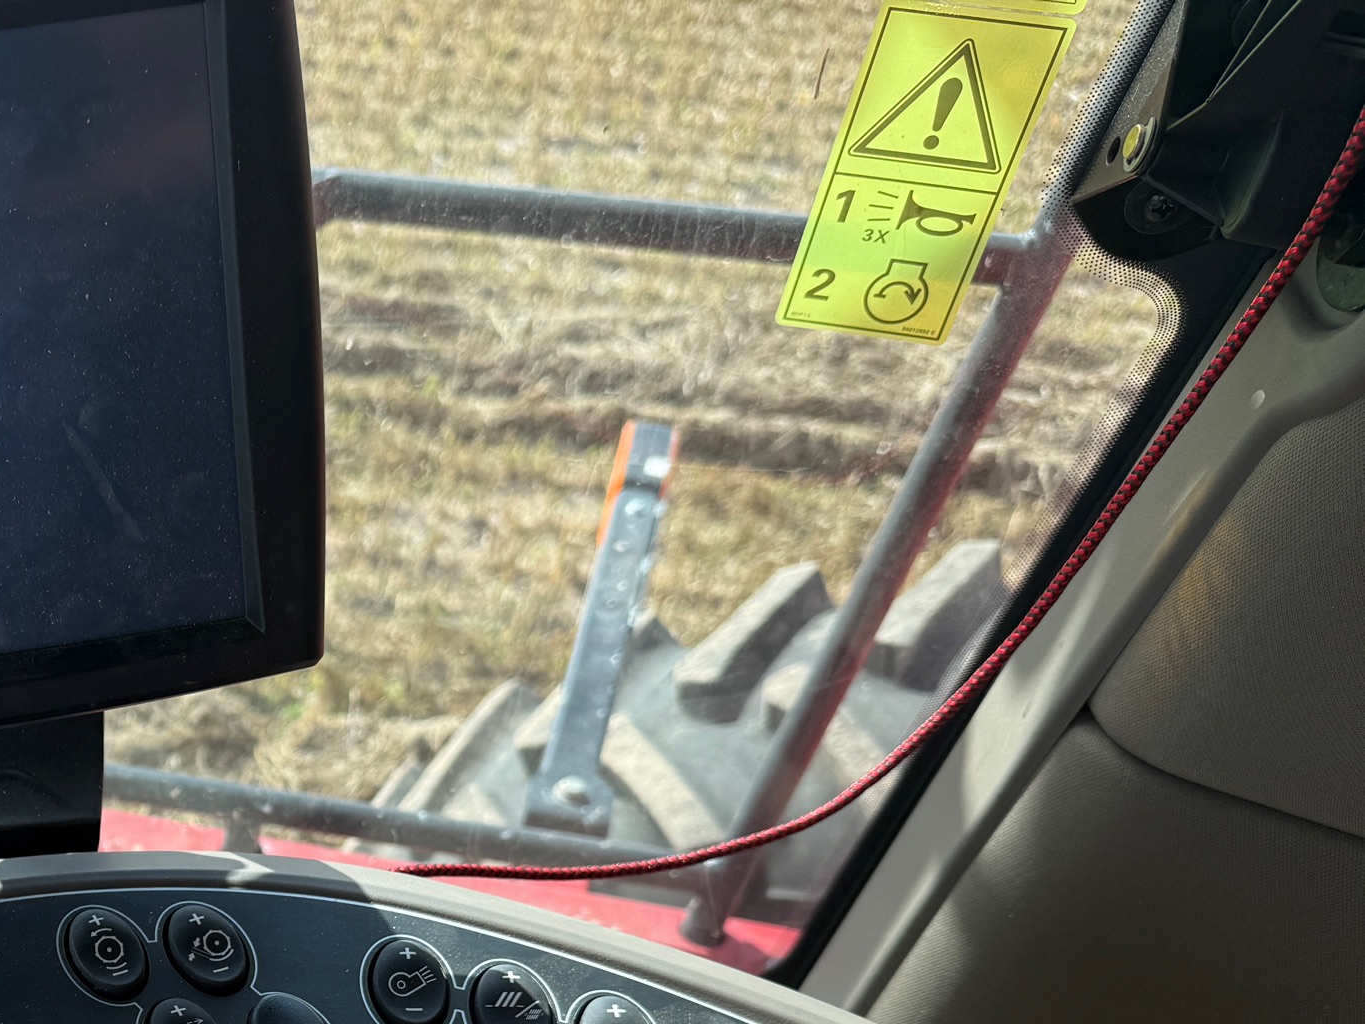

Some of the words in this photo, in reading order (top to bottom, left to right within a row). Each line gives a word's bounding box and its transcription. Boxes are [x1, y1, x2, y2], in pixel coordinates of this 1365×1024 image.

[835, 189, 856, 223] 1
[861, 228, 890, 244] 3X
[804, 268, 836, 301] 2
